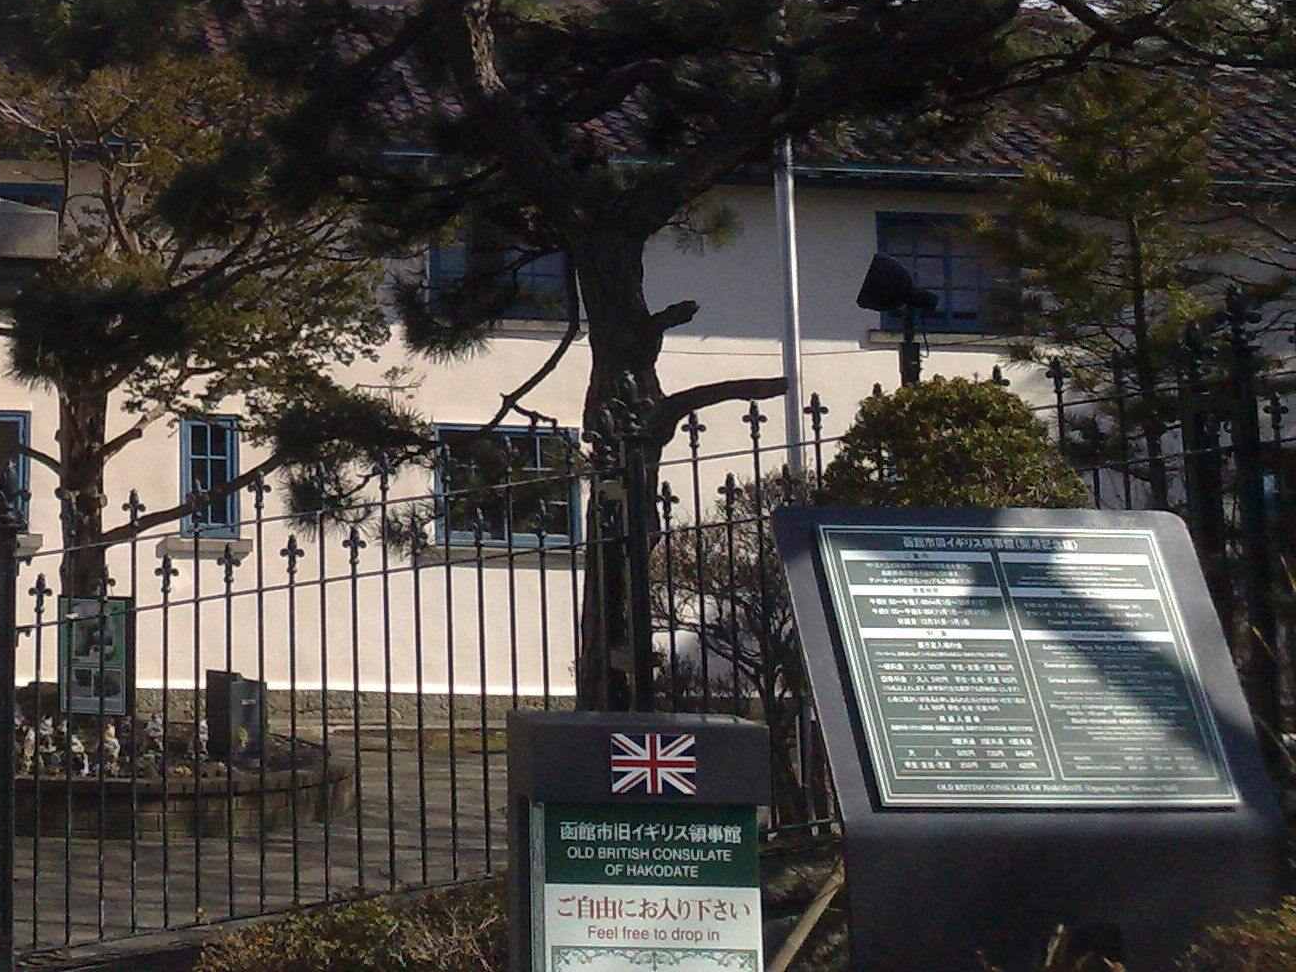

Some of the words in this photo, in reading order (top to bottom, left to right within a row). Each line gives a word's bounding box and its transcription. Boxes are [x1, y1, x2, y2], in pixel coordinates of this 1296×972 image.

[560, 821, 742, 844] 函館市旧イギリス領事館
[567, 846, 594, 859] OLD
[598, 847, 649, 860] BRITISH
[652, 848, 732, 862] CONSULATE
[604, 863, 624, 876] OF
[626, 864, 699, 878] HAKODATE
[557, 895, 751, 922] ご自由にお入り下さい
[587, 925, 618, 940] Feel
[622, 926, 649, 940] free
[653, 928, 667, 941] to
[671, 928, 703, 943] drop
[707, 929, 720, 941] in
